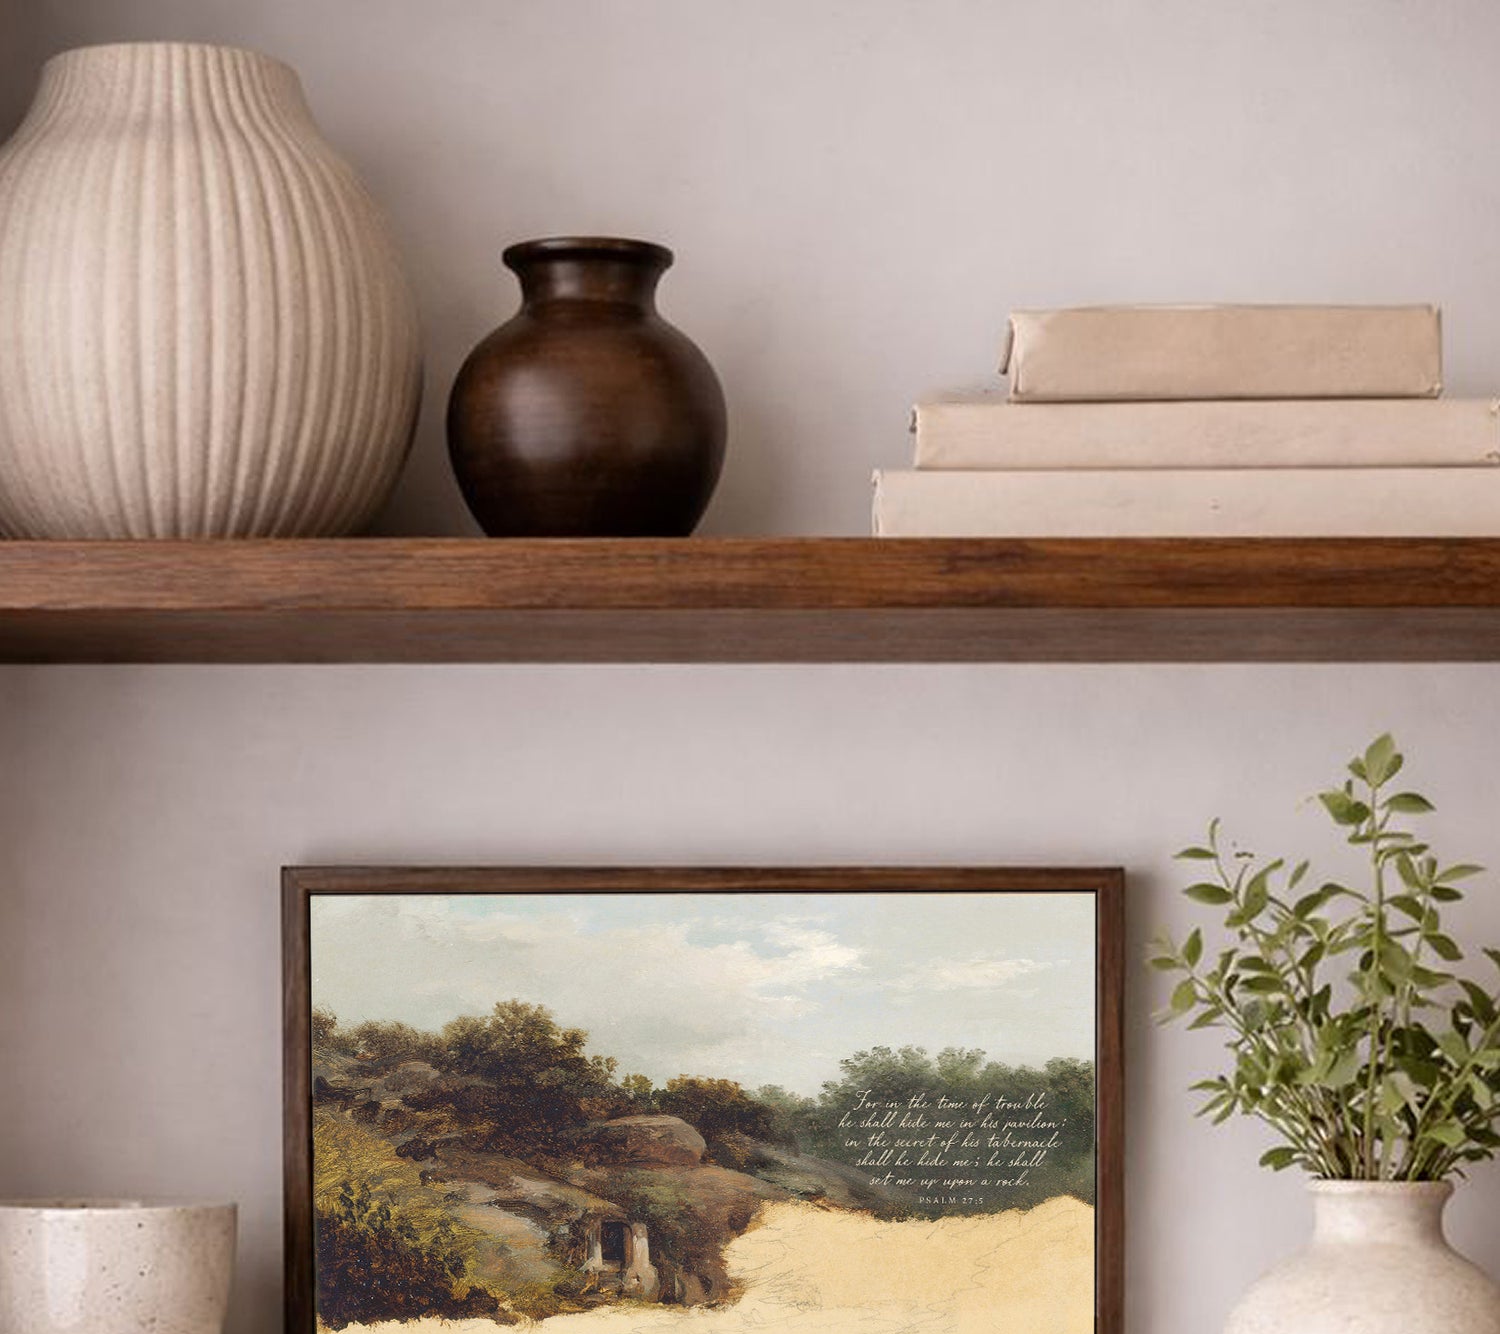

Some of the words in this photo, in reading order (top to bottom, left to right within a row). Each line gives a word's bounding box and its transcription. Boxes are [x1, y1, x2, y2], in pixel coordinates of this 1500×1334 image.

[853, 1089, 881, 1111] For
[886, 1100, 902, 1109] in
[907, 1093, 932, 1109] the
[936, 1095, 968, 1109] time
[972, 1093, 990, 1114] of
[995, 1092, 1050, 1110] trouble
[838, 1112, 856, 1129] he
[860, 1112, 898, 1129] shall
[898, 1111, 931, 1129] hide
[960, 1120, 976, 1128] in
[980, 1113, 998, 1129] his
[845, 1138, 860, 1147] in
[867, 1132, 891, 1147] the
[894, 1134, 940, 1148] secret
[940, 1131, 958, 1152] of
[961, 1132, 979, 1147] his
[987, 1131, 1063, 1148] tabernacle
[855, 1150, 893, 1167] shall
[895, 1150, 914, 1167] he
[917, 1151, 949, 1167] hide
[986, 1151, 1007, 1166] he
[1008, 1150, 1047, 1167] shall
[869, 1172, 894, 1186] set
[896, 1178, 915, 1186] me
[920, 1178, 939, 1189] up
[943, 1178, 978, 1189] upon
[981, 1178, 991, 1186] a
